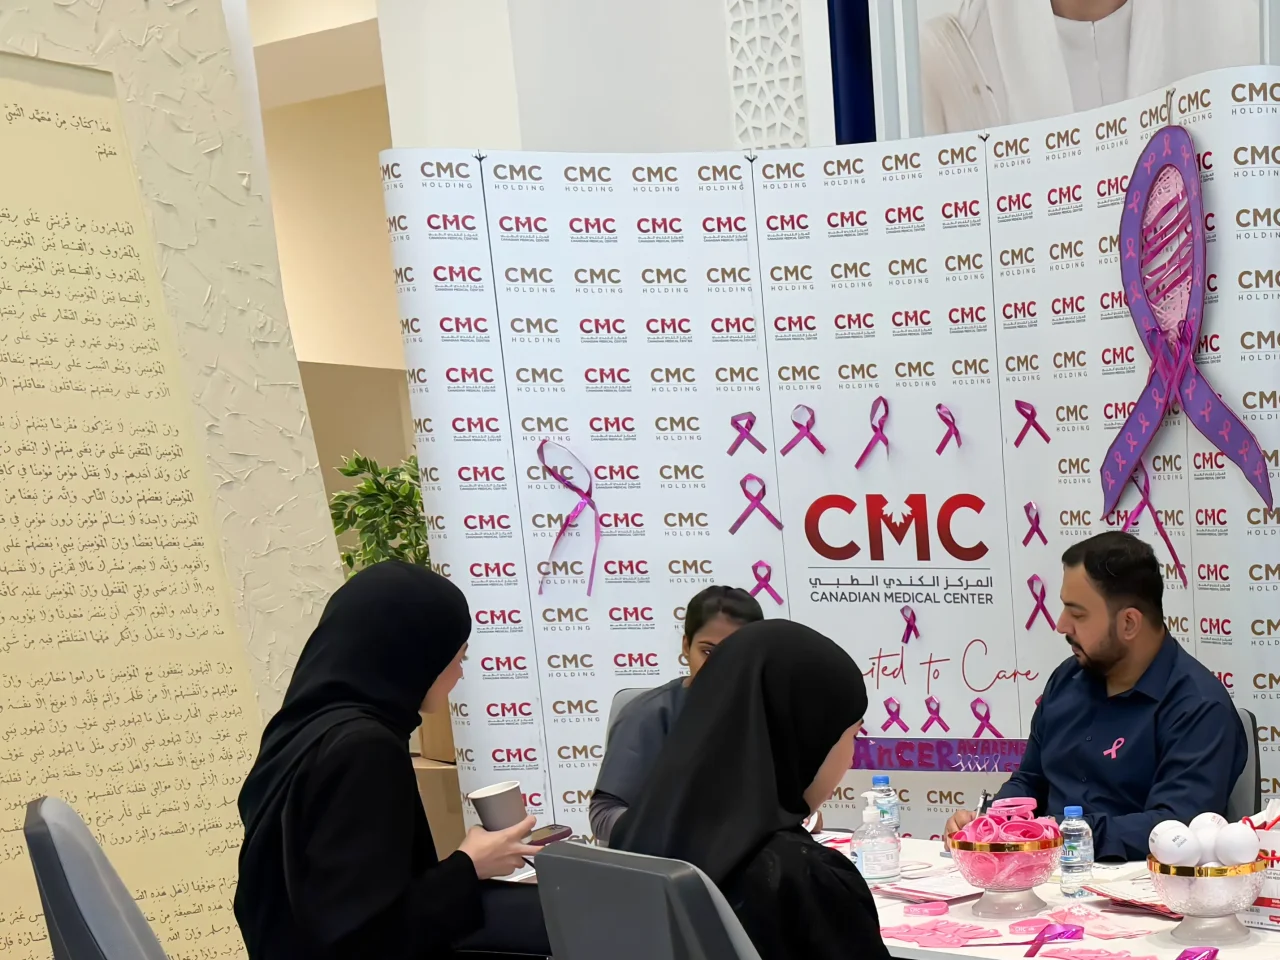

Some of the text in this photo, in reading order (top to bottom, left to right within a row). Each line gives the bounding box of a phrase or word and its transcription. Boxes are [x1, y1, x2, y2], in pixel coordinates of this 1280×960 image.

[938, 146, 977, 165] CMC
[421, 162, 470, 181] CMC
[939, 166, 978, 176] HOLDING
[499, 216, 548, 234] CMC
[1058, 458, 1090, 476] CMC
[804, 493, 989, 561] CMC
[809, 575, 993, 590] المركز الكندي الطبي
[810, 591, 993, 604] CANADIAN MEDICAL CENTER
[542, 608, 588, 622] CMC
[543, 623, 590, 631] HOLDING
[481, 656, 527, 671] CMC
[919, 653, 950, 695] to
[962, 639, 1039, 692] Care
